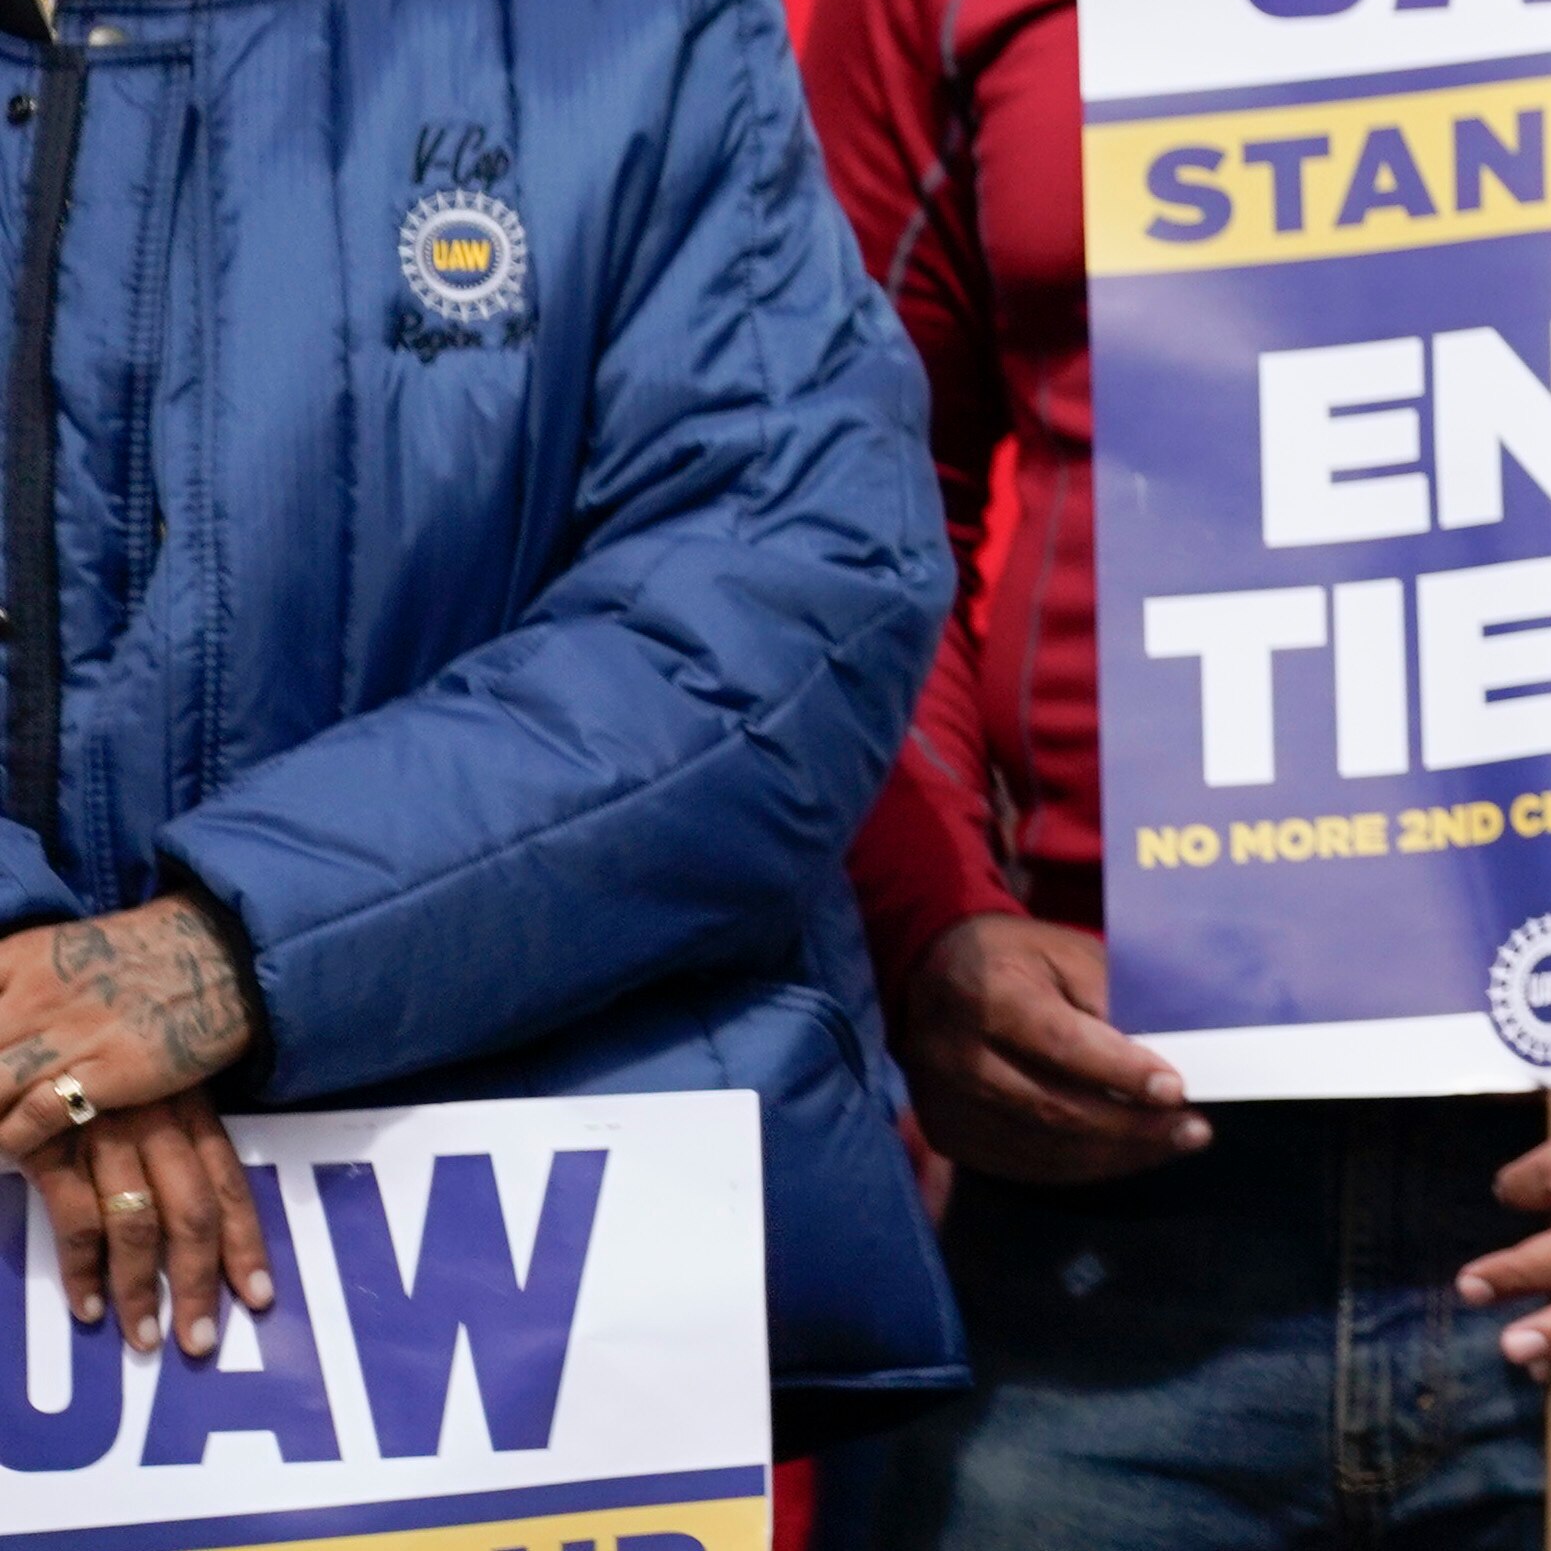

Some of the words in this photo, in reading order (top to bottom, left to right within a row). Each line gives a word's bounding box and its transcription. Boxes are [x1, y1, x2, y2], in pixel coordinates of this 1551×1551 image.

[433, 238, 491, 272] UAW
[1136, 823, 1220, 870] NO
[1229, 811, 1389, 864] MORE
[1397, 798, 1505, 851] 2ND
[0, 1148, 609, 1473] UAW
